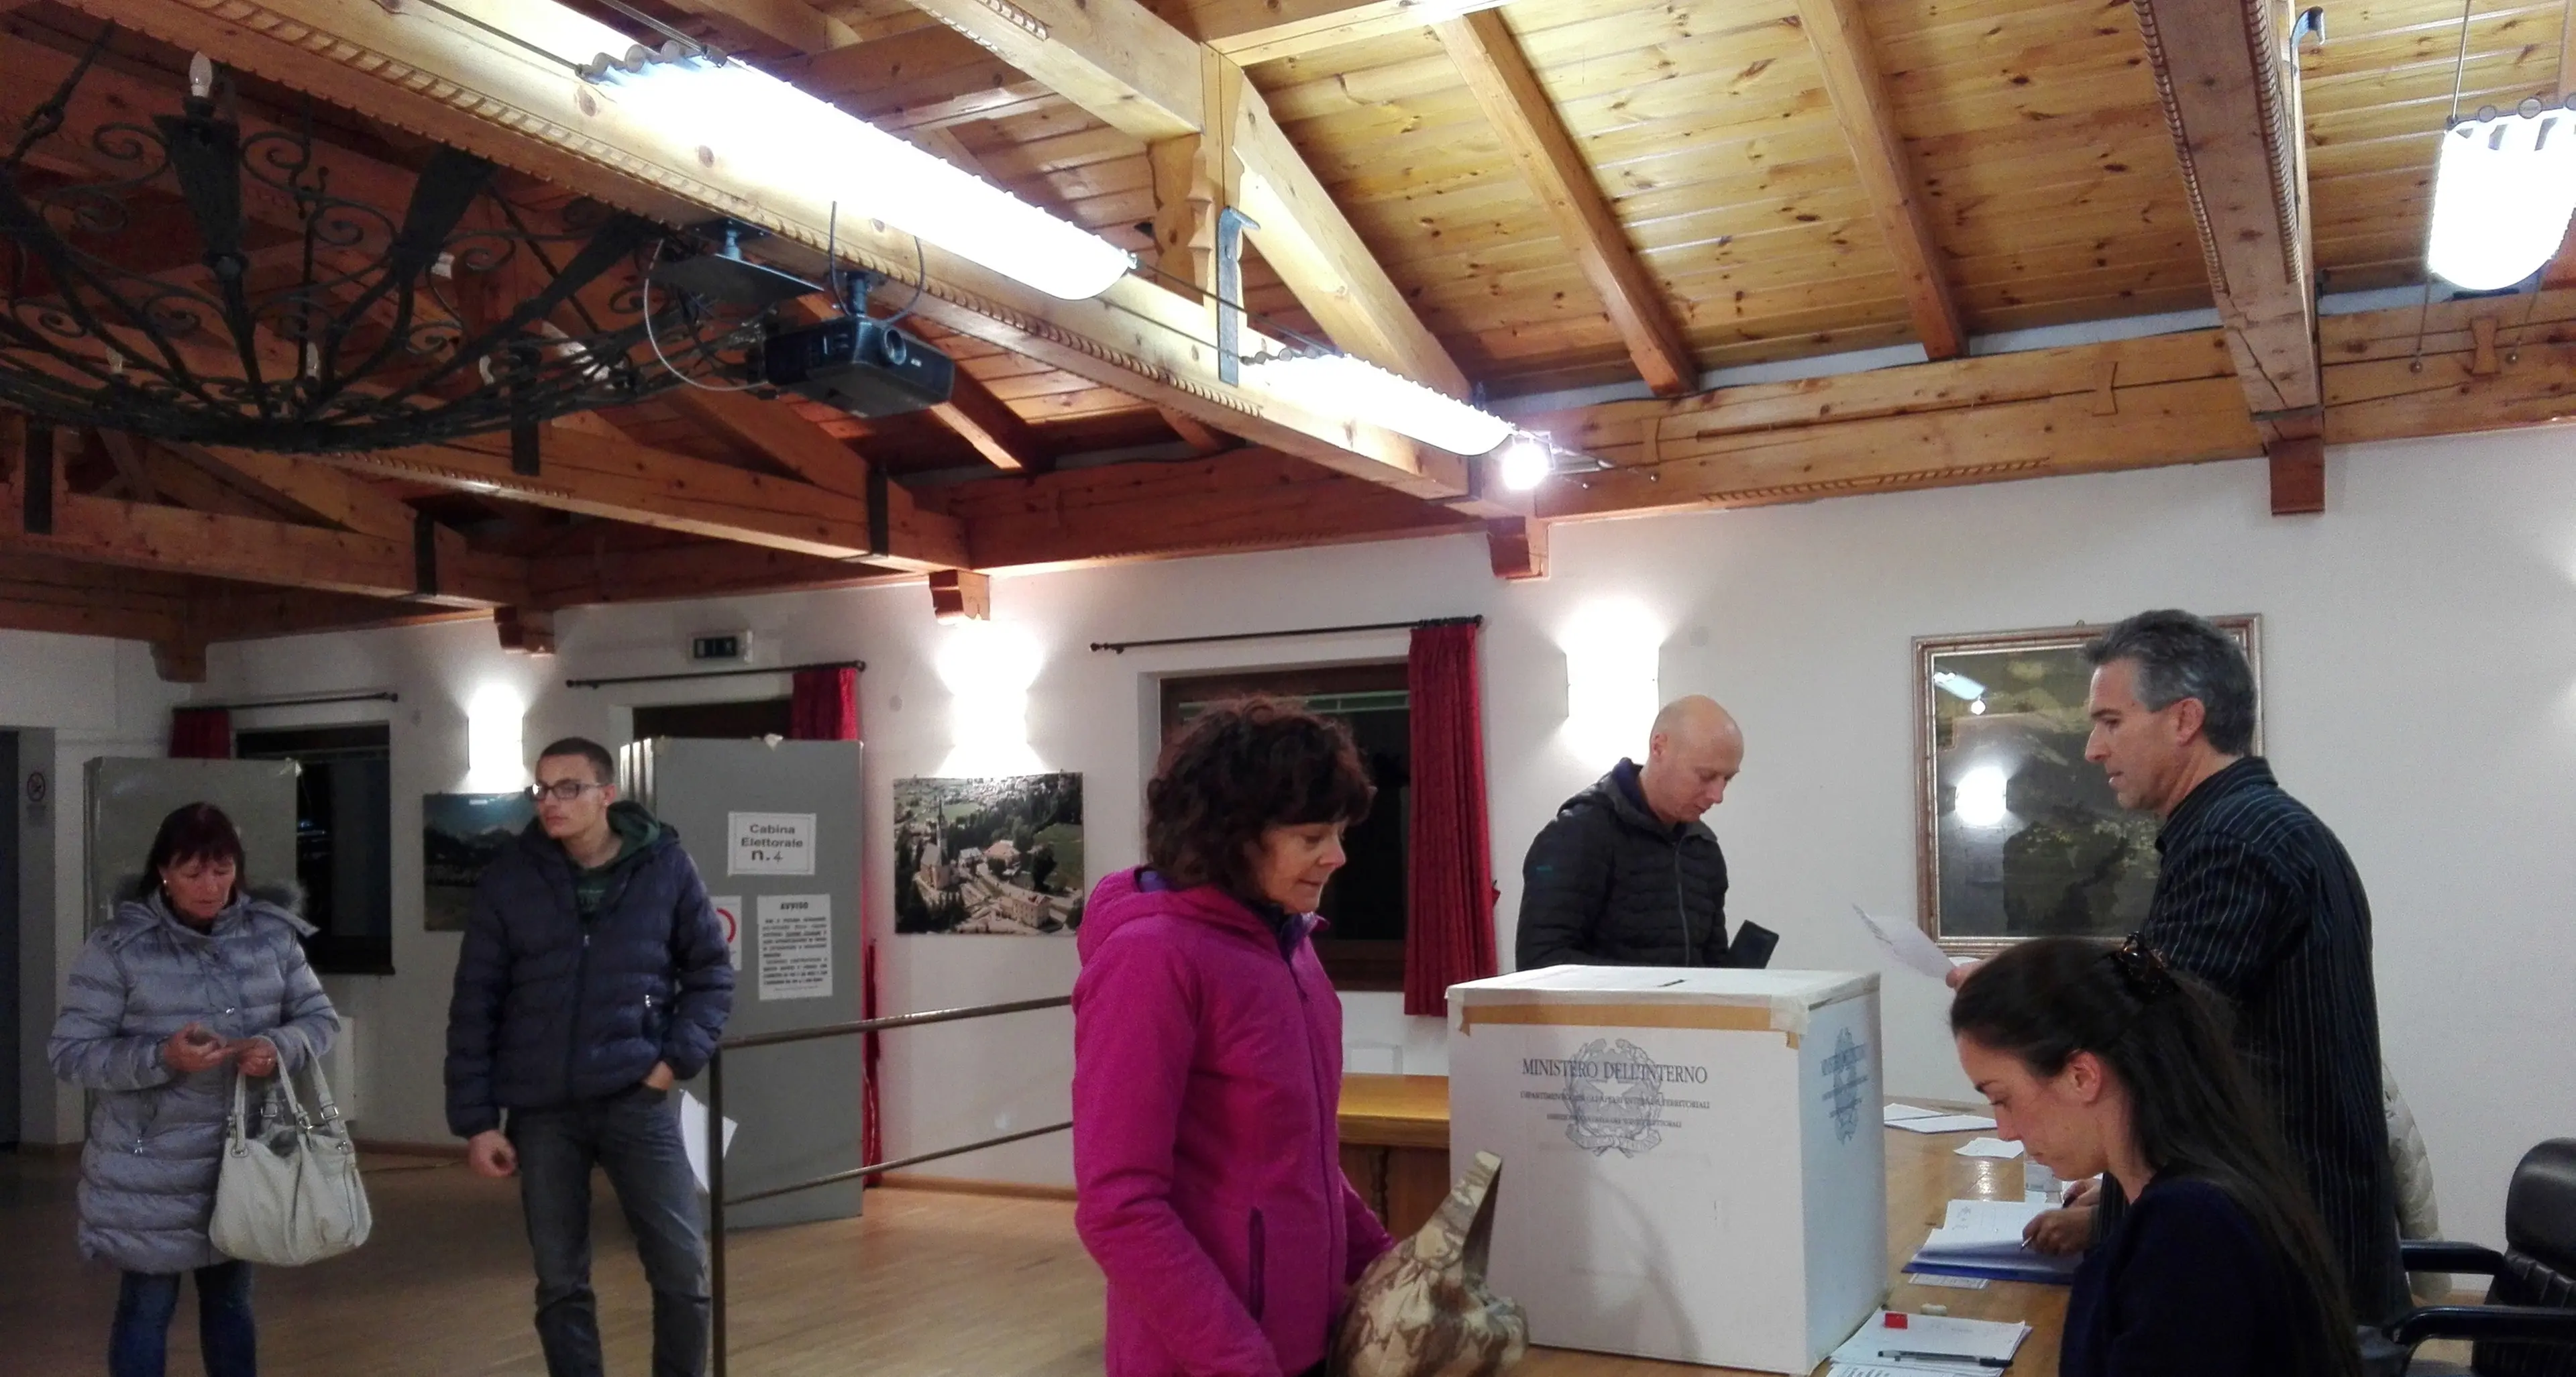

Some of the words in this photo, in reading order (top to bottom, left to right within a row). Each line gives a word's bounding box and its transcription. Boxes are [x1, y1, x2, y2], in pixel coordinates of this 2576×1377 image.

[749, 823, 795, 834] Cabina
[741, 836, 803, 848] Elettorale
[1522, 1058, 1598, 1079] MINISTERO
[1603, 1061, 1708, 1084] DELL'INTERNO
